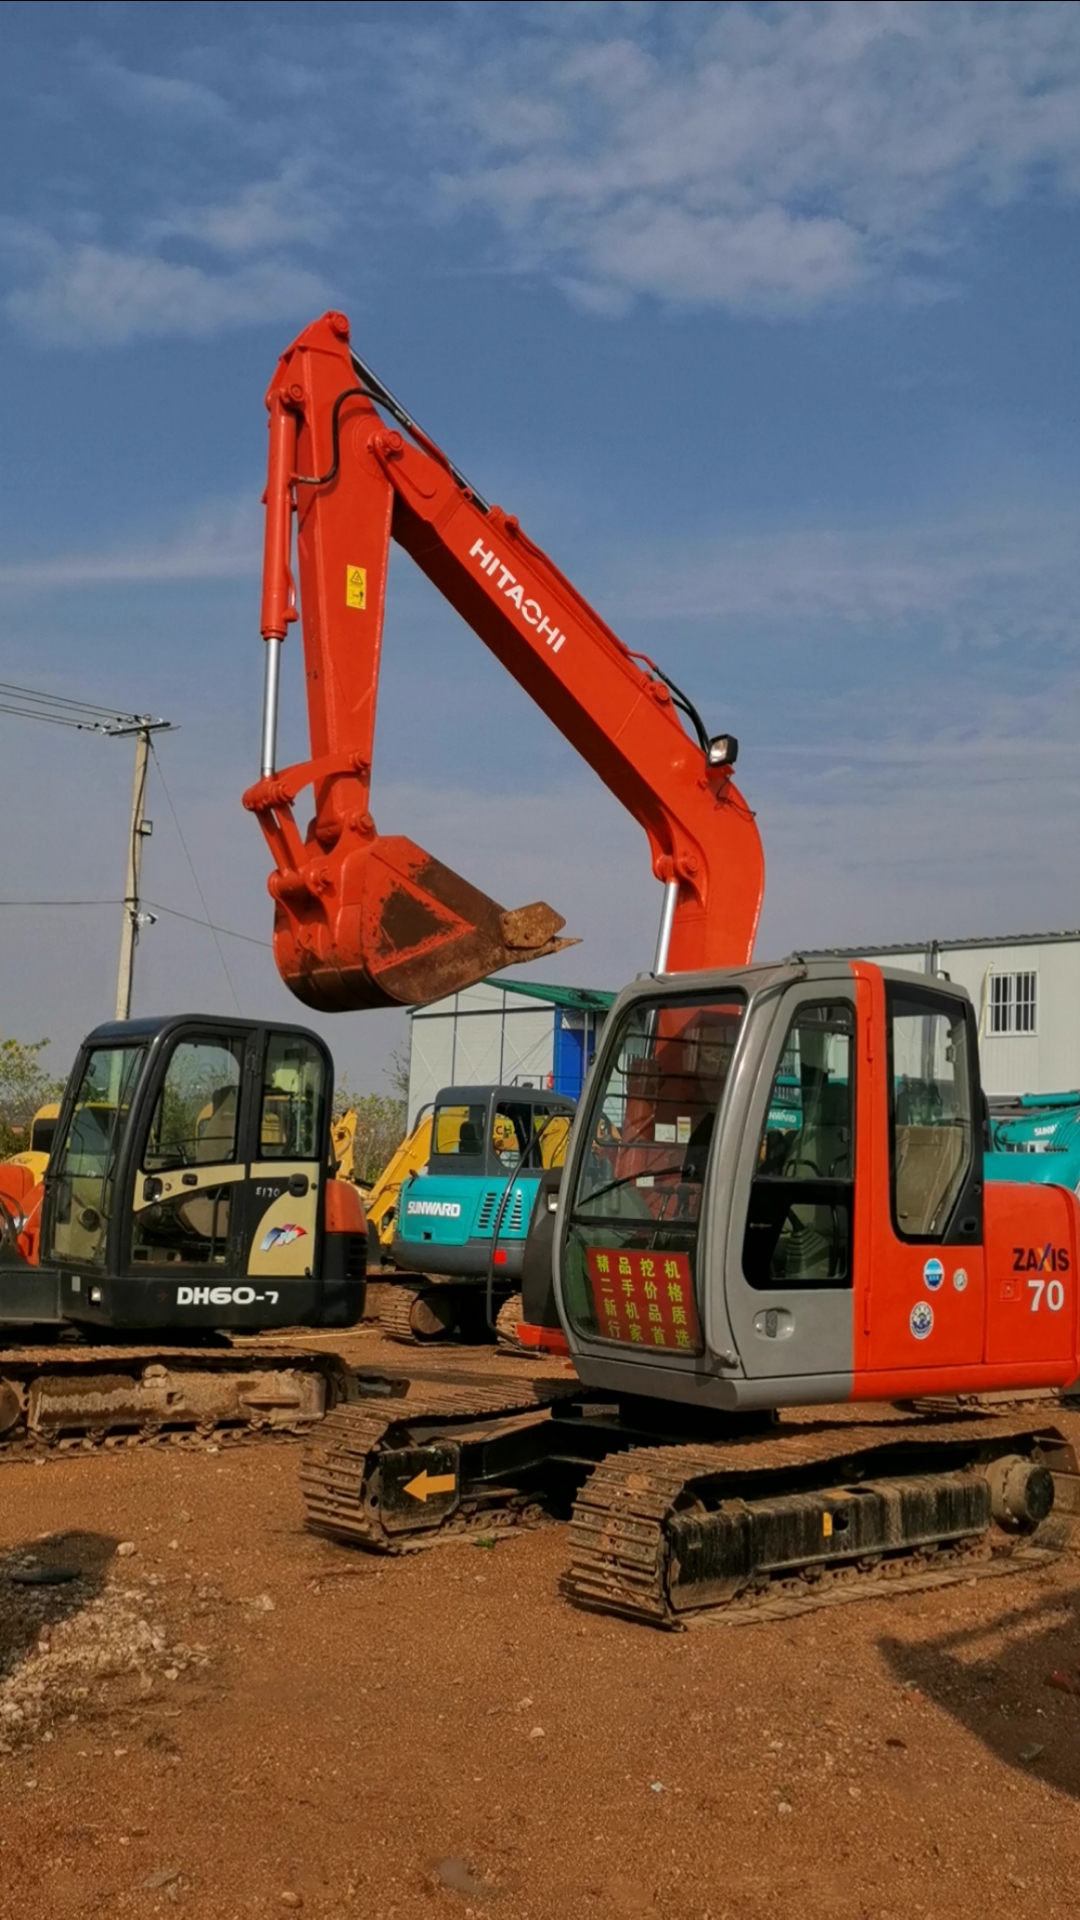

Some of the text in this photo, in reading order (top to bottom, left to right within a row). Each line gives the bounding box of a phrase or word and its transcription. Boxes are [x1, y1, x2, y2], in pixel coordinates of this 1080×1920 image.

[469, 538, 566, 653] HITACHI
[407, 1200, 461, 1217] SUNWARD
[596, 1254, 681, 1279] 精品挖机
[1012, 1242, 1069, 1272] ZAXIS
[176, 1286, 279, 1305] DH60-7
[601, 1278, 683, 1302] 二手价格
[1027, 1279, 1065, 1312] 70
[604, 1298, 687, 1325] 新机品质
[607, 1320, 691, 1348] 行家首选
